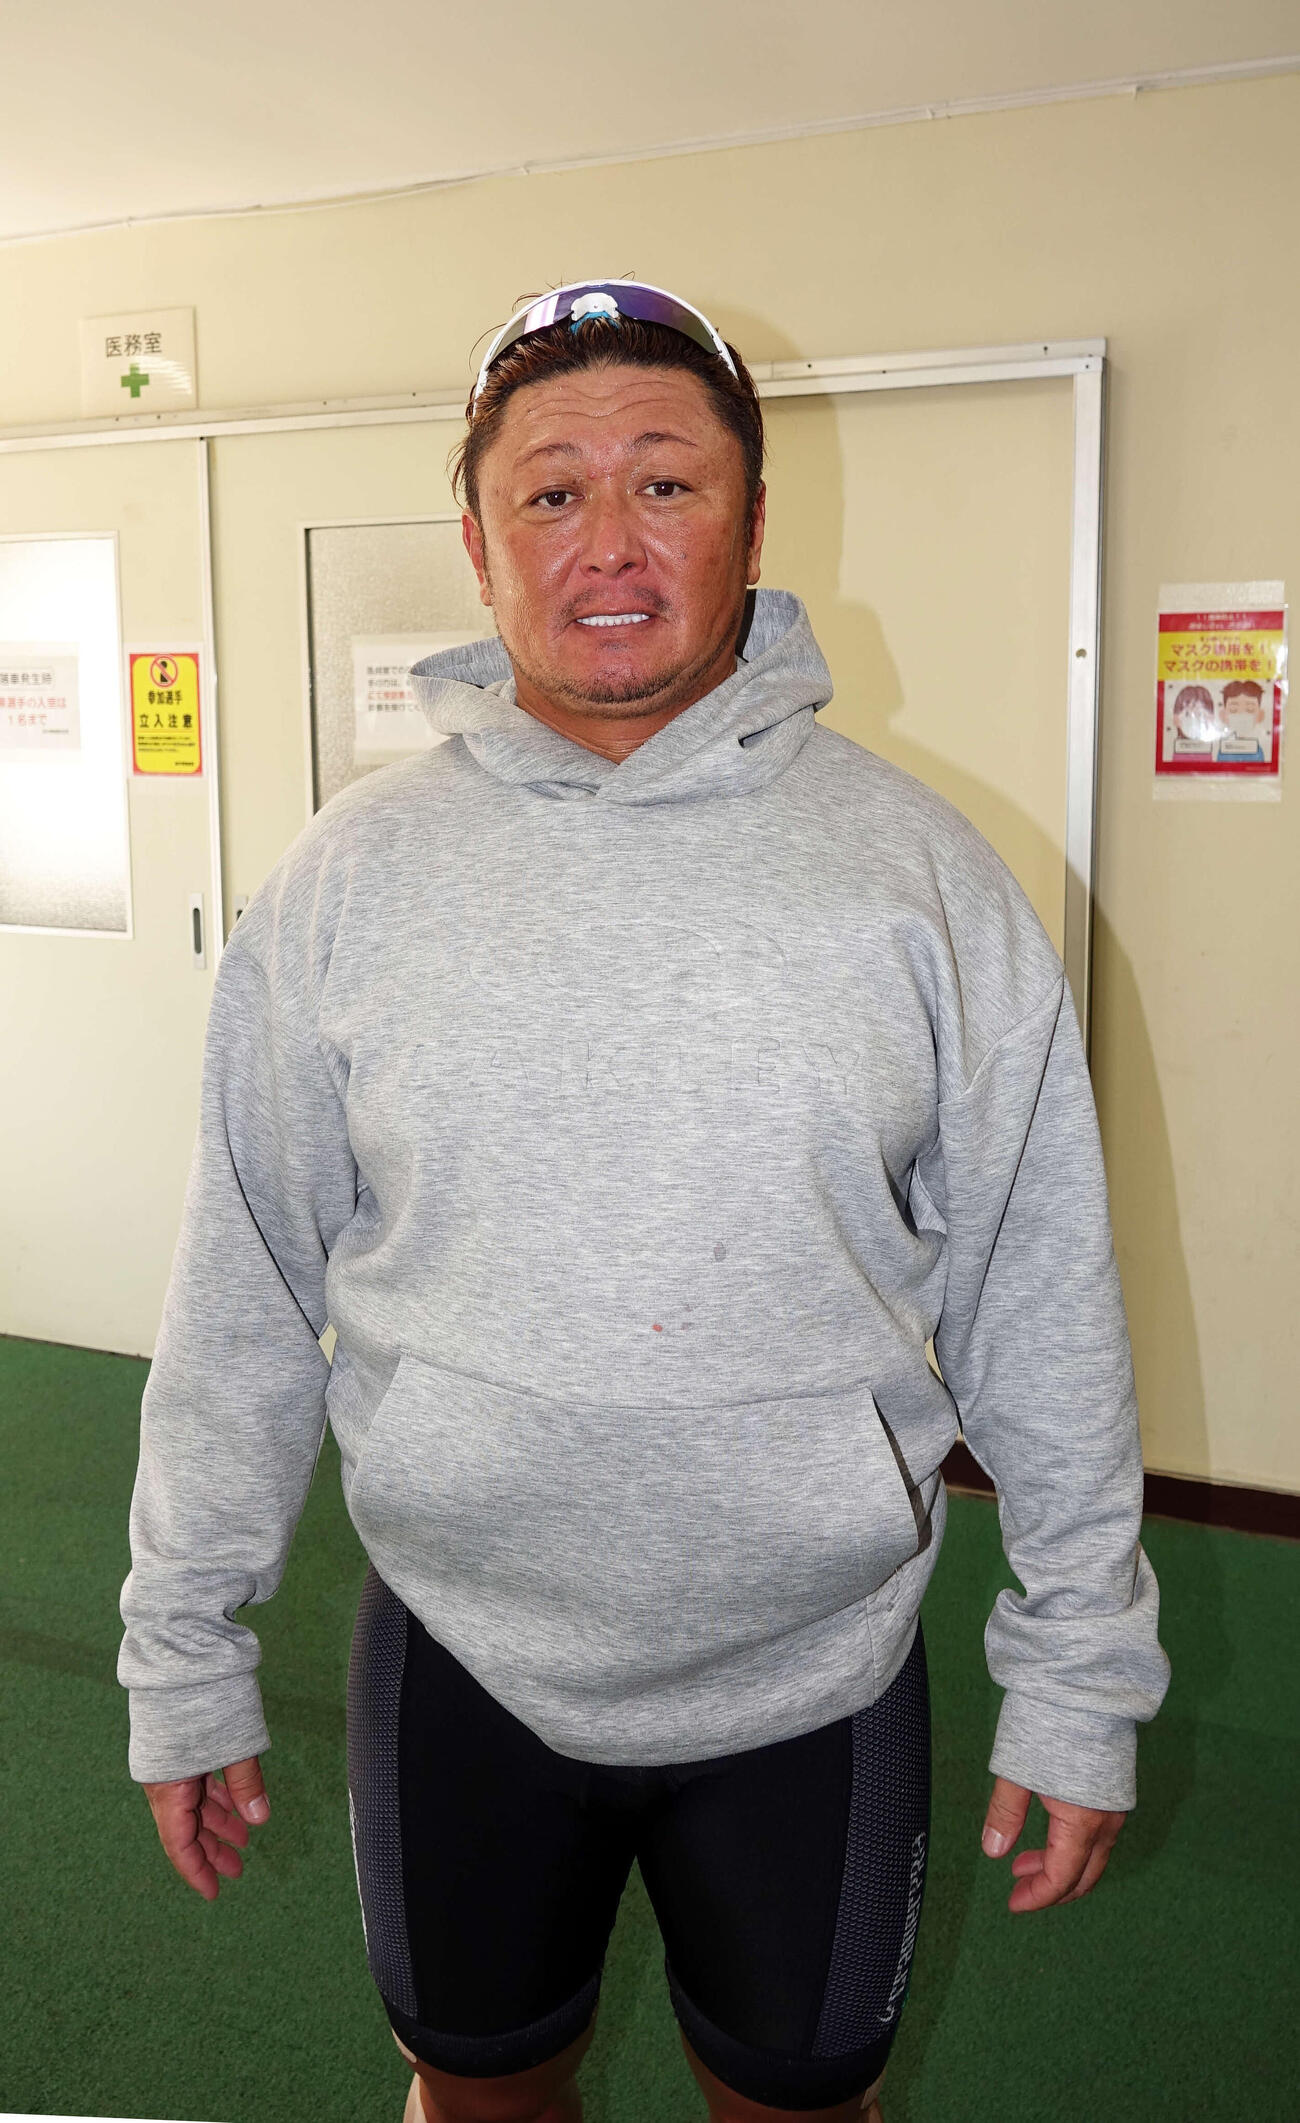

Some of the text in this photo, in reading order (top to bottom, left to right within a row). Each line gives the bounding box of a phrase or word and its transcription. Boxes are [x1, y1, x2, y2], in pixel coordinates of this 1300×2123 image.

[105, 331, 162, 358] 医務室
[139, 713, 193, 728] 立入注意
[398, 1037, 860, 1098] AKLEY
